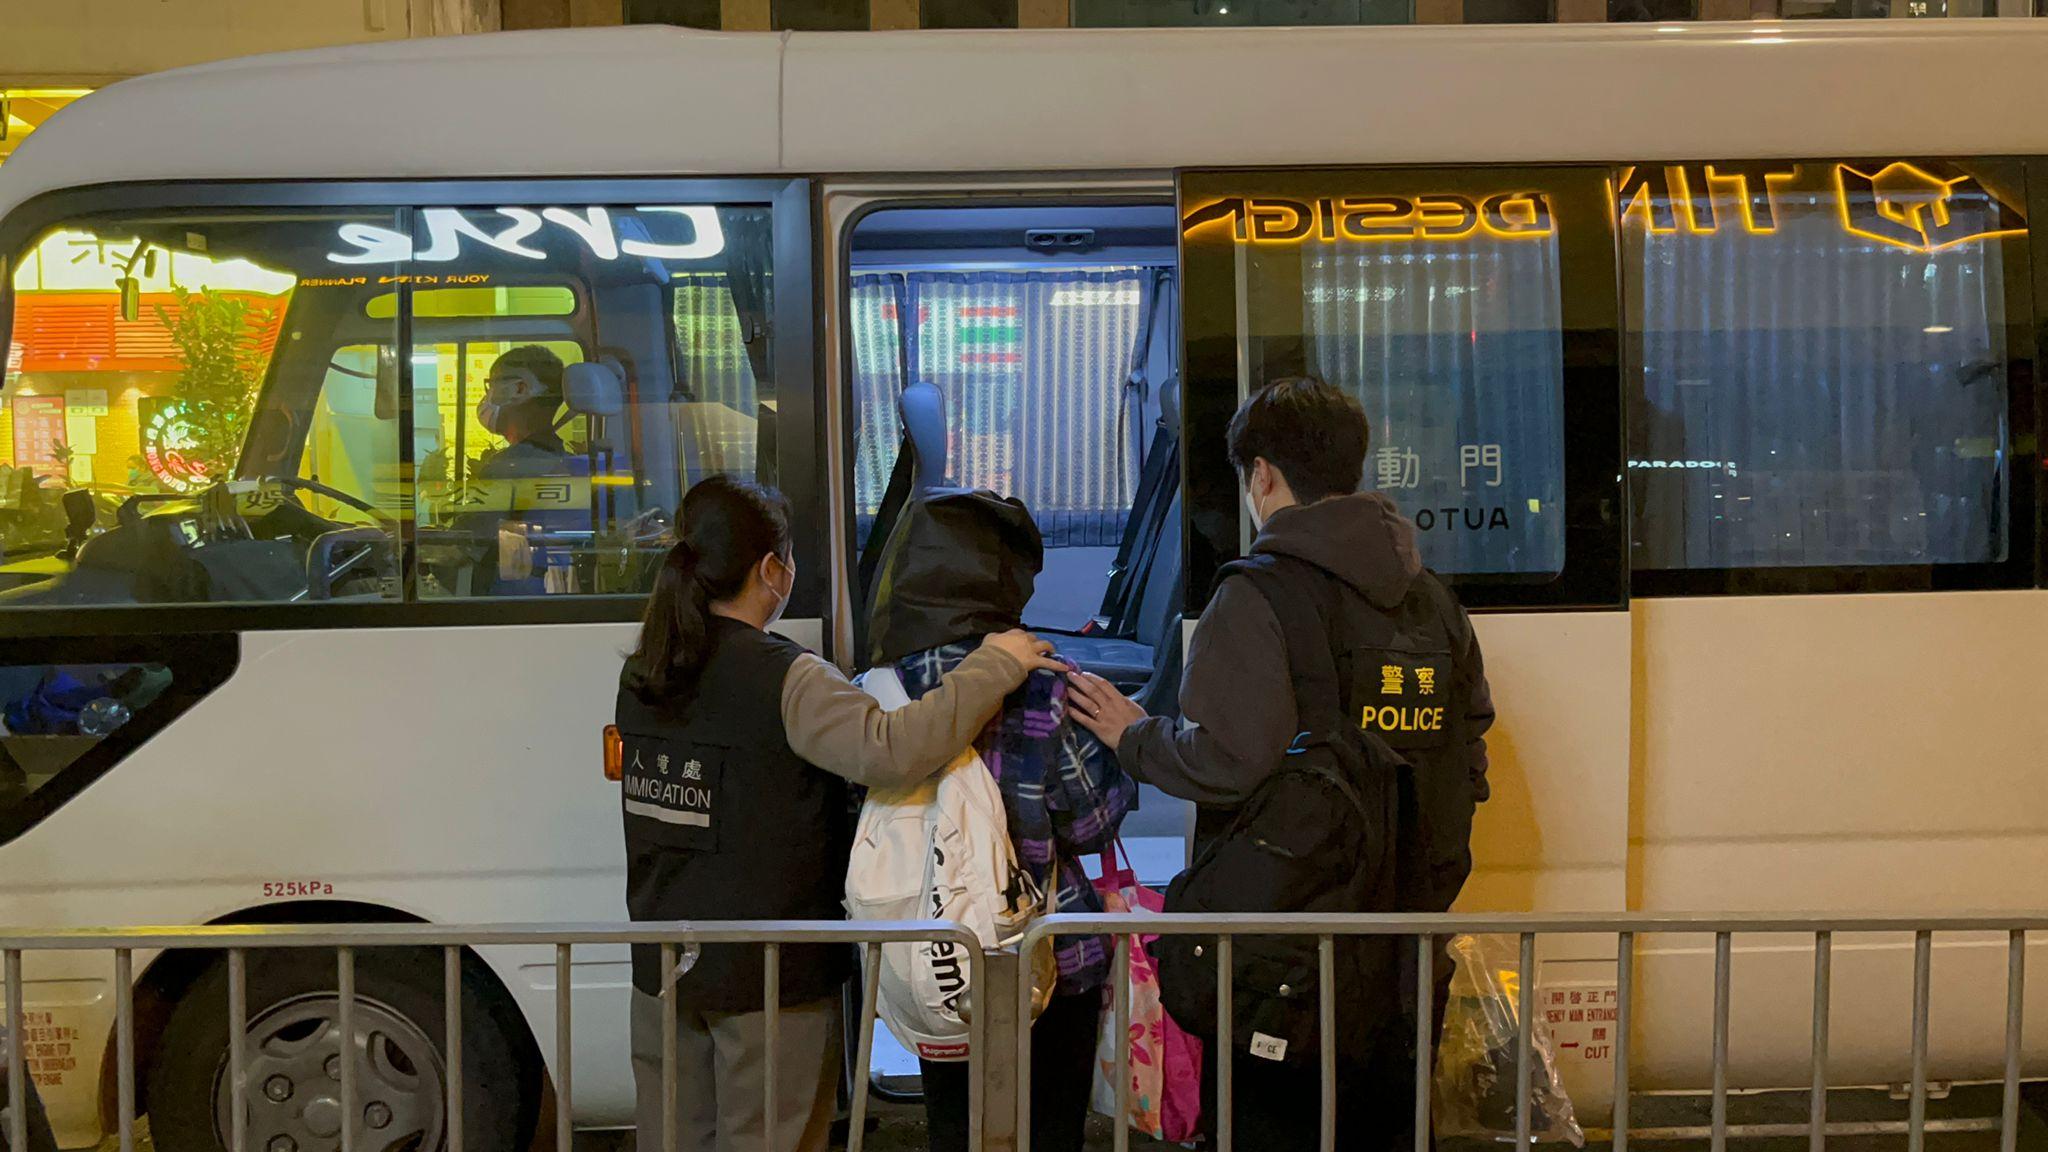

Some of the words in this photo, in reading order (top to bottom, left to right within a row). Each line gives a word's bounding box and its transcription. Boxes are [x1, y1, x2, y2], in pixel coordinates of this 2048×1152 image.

[1381, 665, 1435, 695] 警察
[1361, 705, 1444, 731] POLICE
[625, 774, 711, 809] IMMIGATION
[263, 881, 333, 897] 525kPa
[1584, 1045, 1610, 1060] CUT
